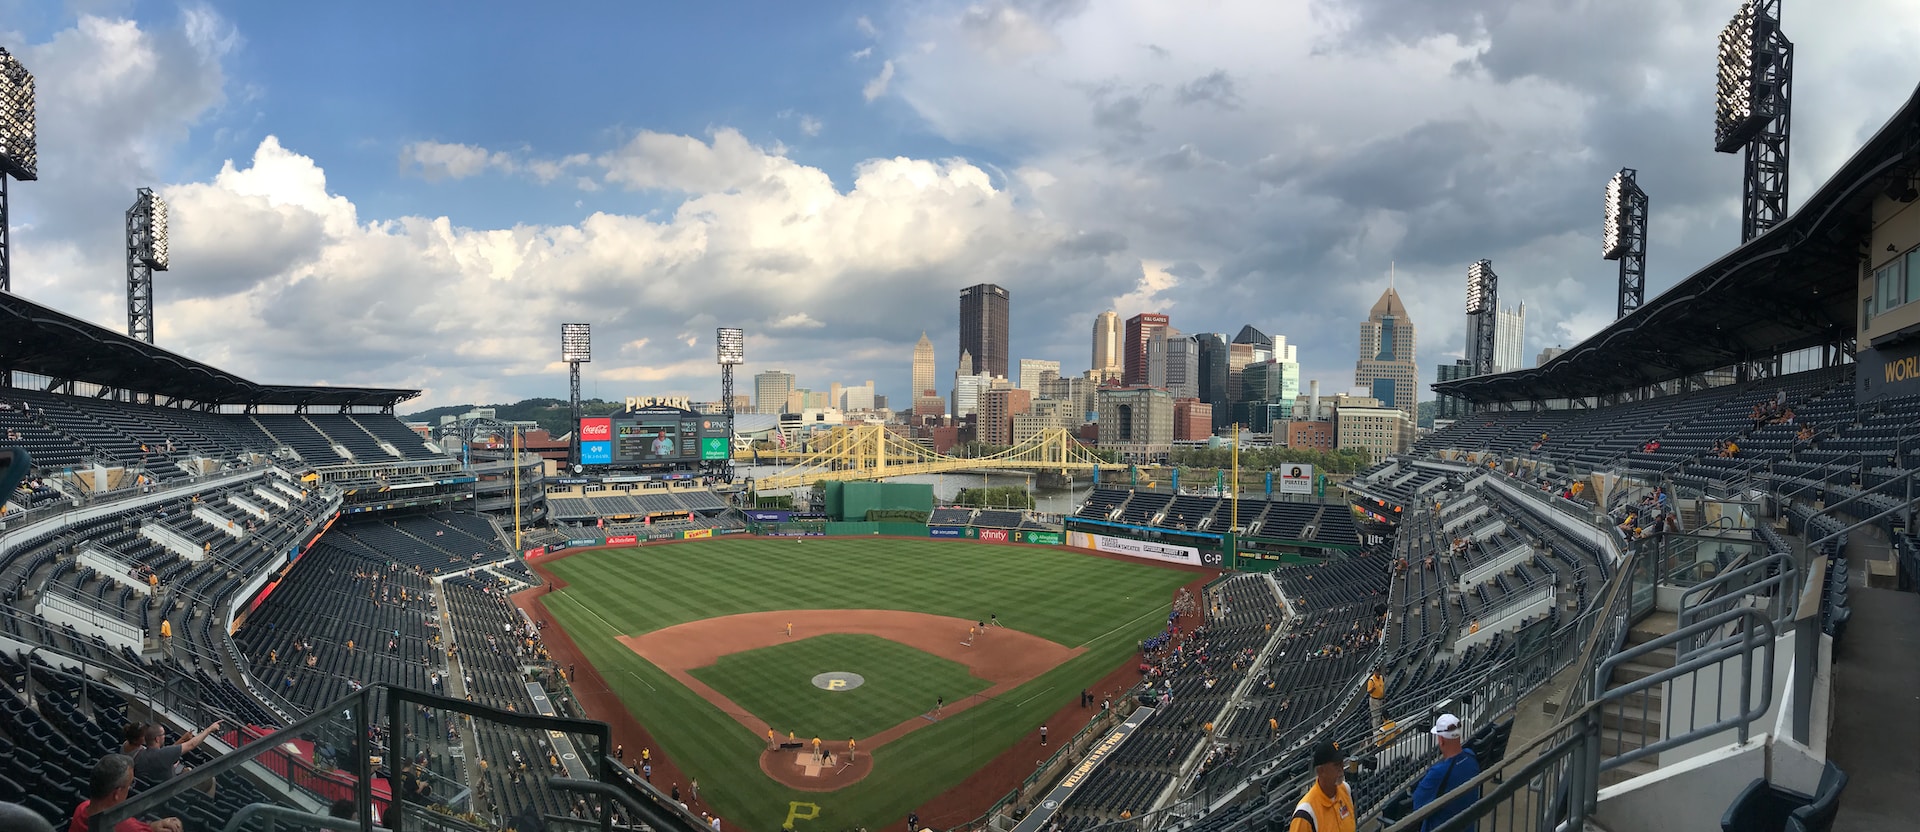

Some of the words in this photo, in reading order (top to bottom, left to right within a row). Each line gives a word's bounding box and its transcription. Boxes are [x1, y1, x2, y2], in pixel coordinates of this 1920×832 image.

[1885, 356, 1920, 383] WORL
[625, 396, 653, 414] PNC
[656, 396, 692, 412] PARK
[981, 530, 1006, 540] xfinity
[1015, 532, 1022, 541] P
[1368, 534, 1384, 545] Lite
[826, 679, 847, 690] P
[1062, 760, 1095, 787] WELCOME
[1095, 744, 1112, 755] PNC
[1106, 732, 1125, 745] PARK
[783, 801, 821, 829] P
